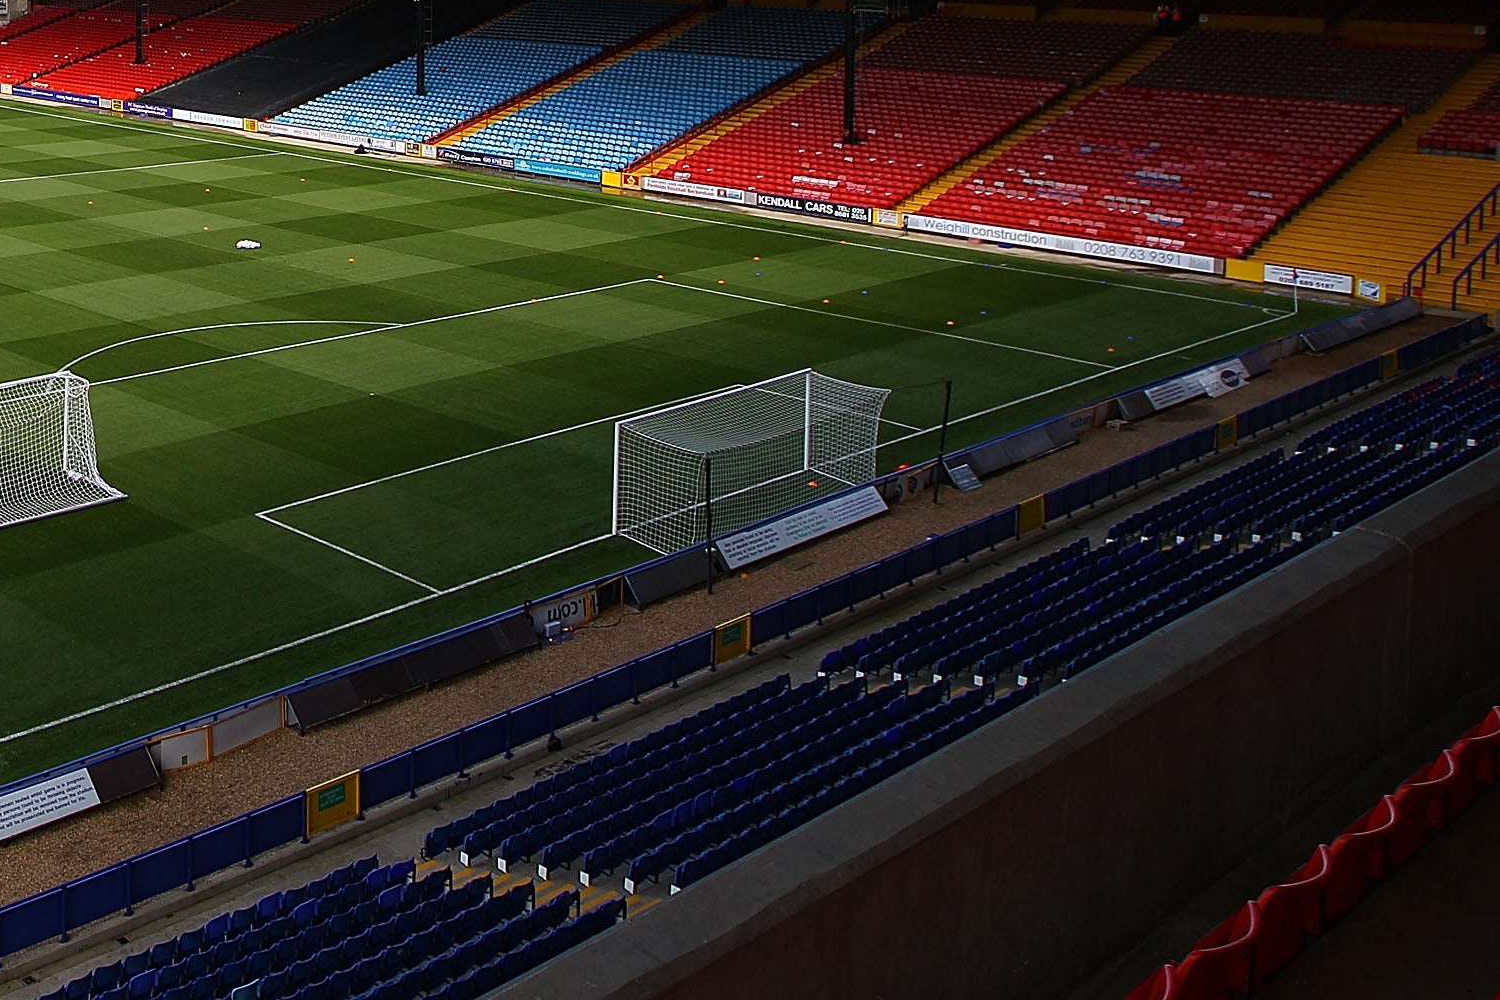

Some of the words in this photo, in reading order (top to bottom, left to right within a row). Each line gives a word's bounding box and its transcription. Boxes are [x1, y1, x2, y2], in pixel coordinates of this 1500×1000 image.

[758, 194, 802, 210] KENDALL
[806, 202, 834, 214] CARS
[924, 218, 970, 234] Weighill
[972, 226, 1047, 246] construction
[1084, 242, 1116, 256] 0208
[1120, 247, 1145, 261] 763
[1150, 251, 1182, 266] 9391
